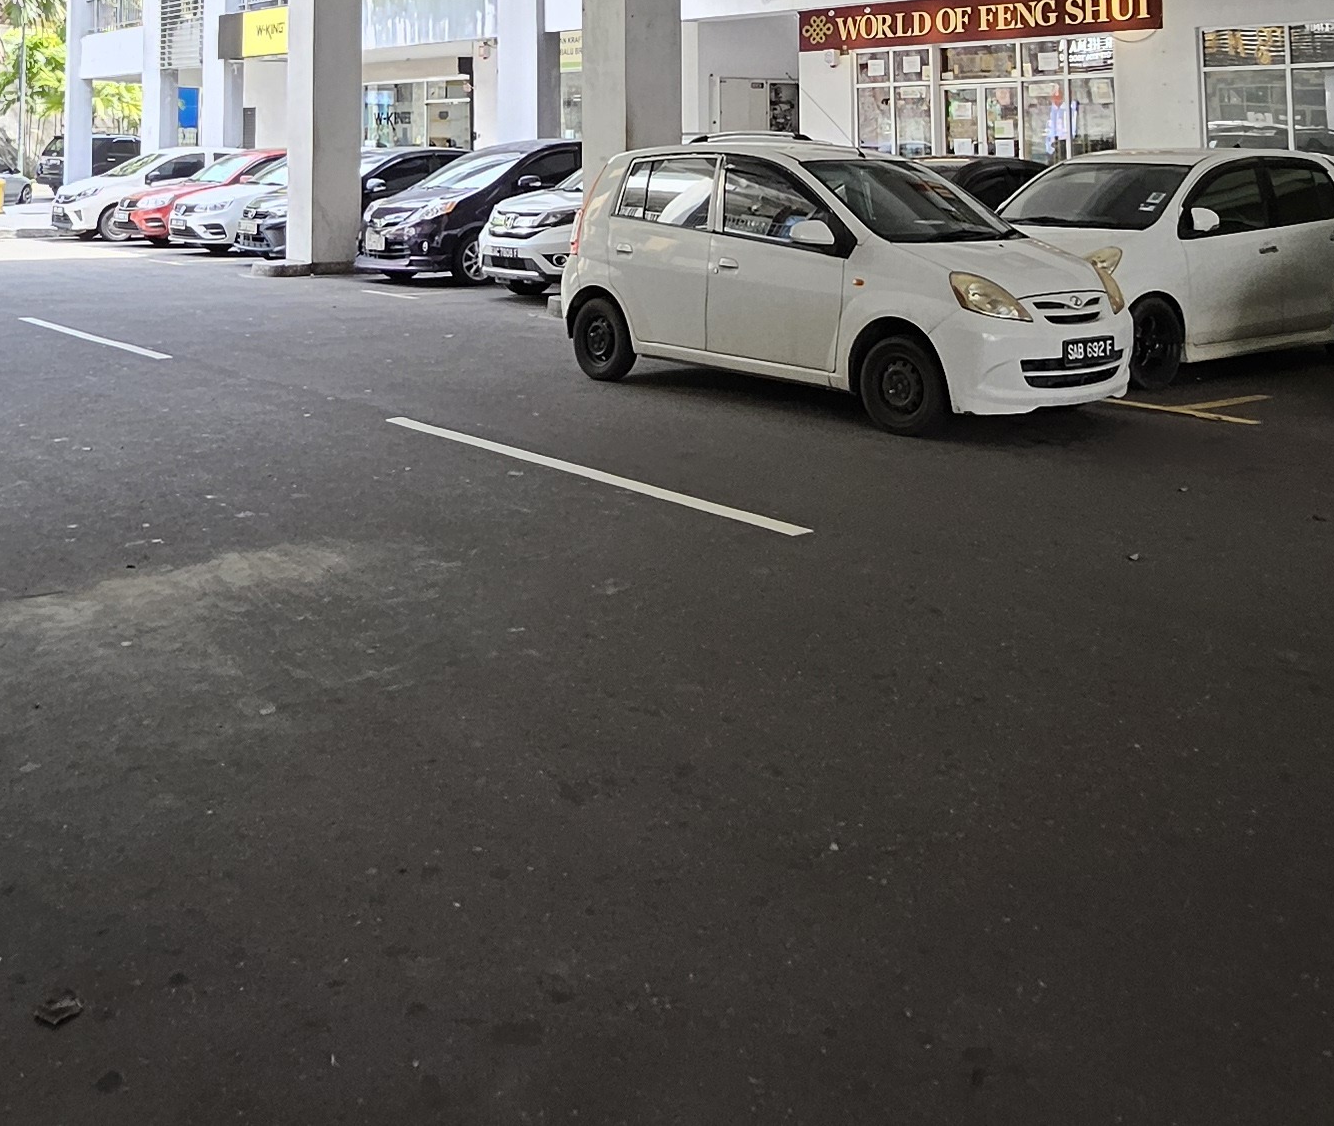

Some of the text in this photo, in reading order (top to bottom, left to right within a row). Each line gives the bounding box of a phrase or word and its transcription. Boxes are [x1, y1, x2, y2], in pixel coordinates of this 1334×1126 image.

[836, 12, 931, 41] WORLD
[936, 7, 971, 35] OF
[978, 0, 1058, 31] FENG
[1067, 340, 1113, 360] SAB 692 F
